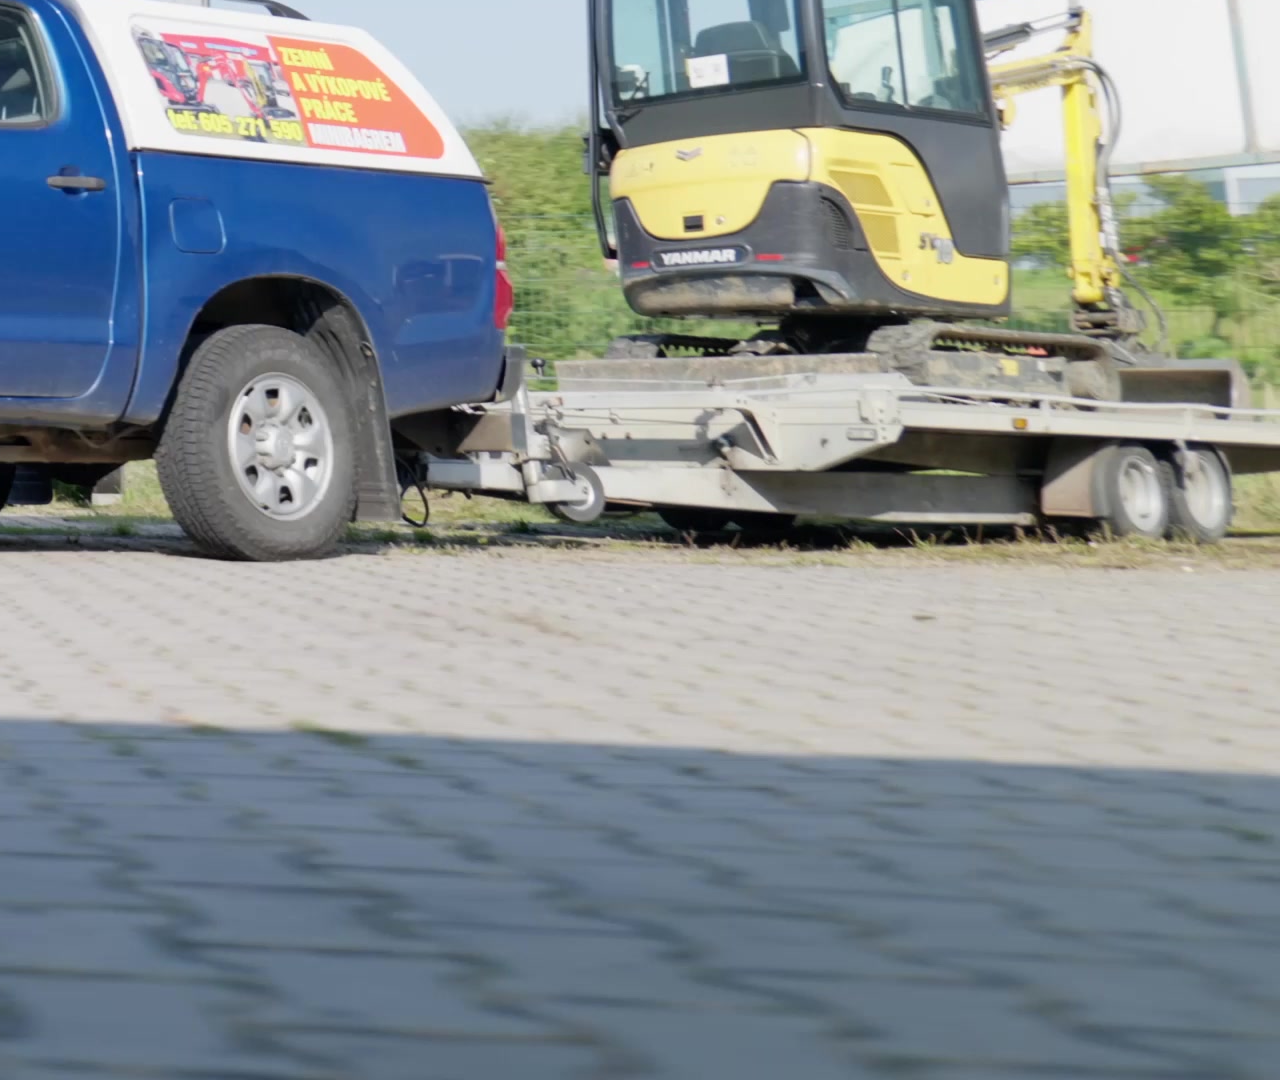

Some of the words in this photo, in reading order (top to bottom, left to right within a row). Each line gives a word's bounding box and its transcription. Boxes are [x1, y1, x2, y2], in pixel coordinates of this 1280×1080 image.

[277, 46, 334, 71] ZEMNÍ
[290, 72, 305, 92] A
[305, 70, 392, 102] VÝKOPOVÉ
[299, 96, 358, 123] PRÁCE
[199, 112, 233, 135] 605
[236, 116, 268, 138] 271
[269, 121, 304, 142] 590
[659, 248, 737, 266] YANMAR
